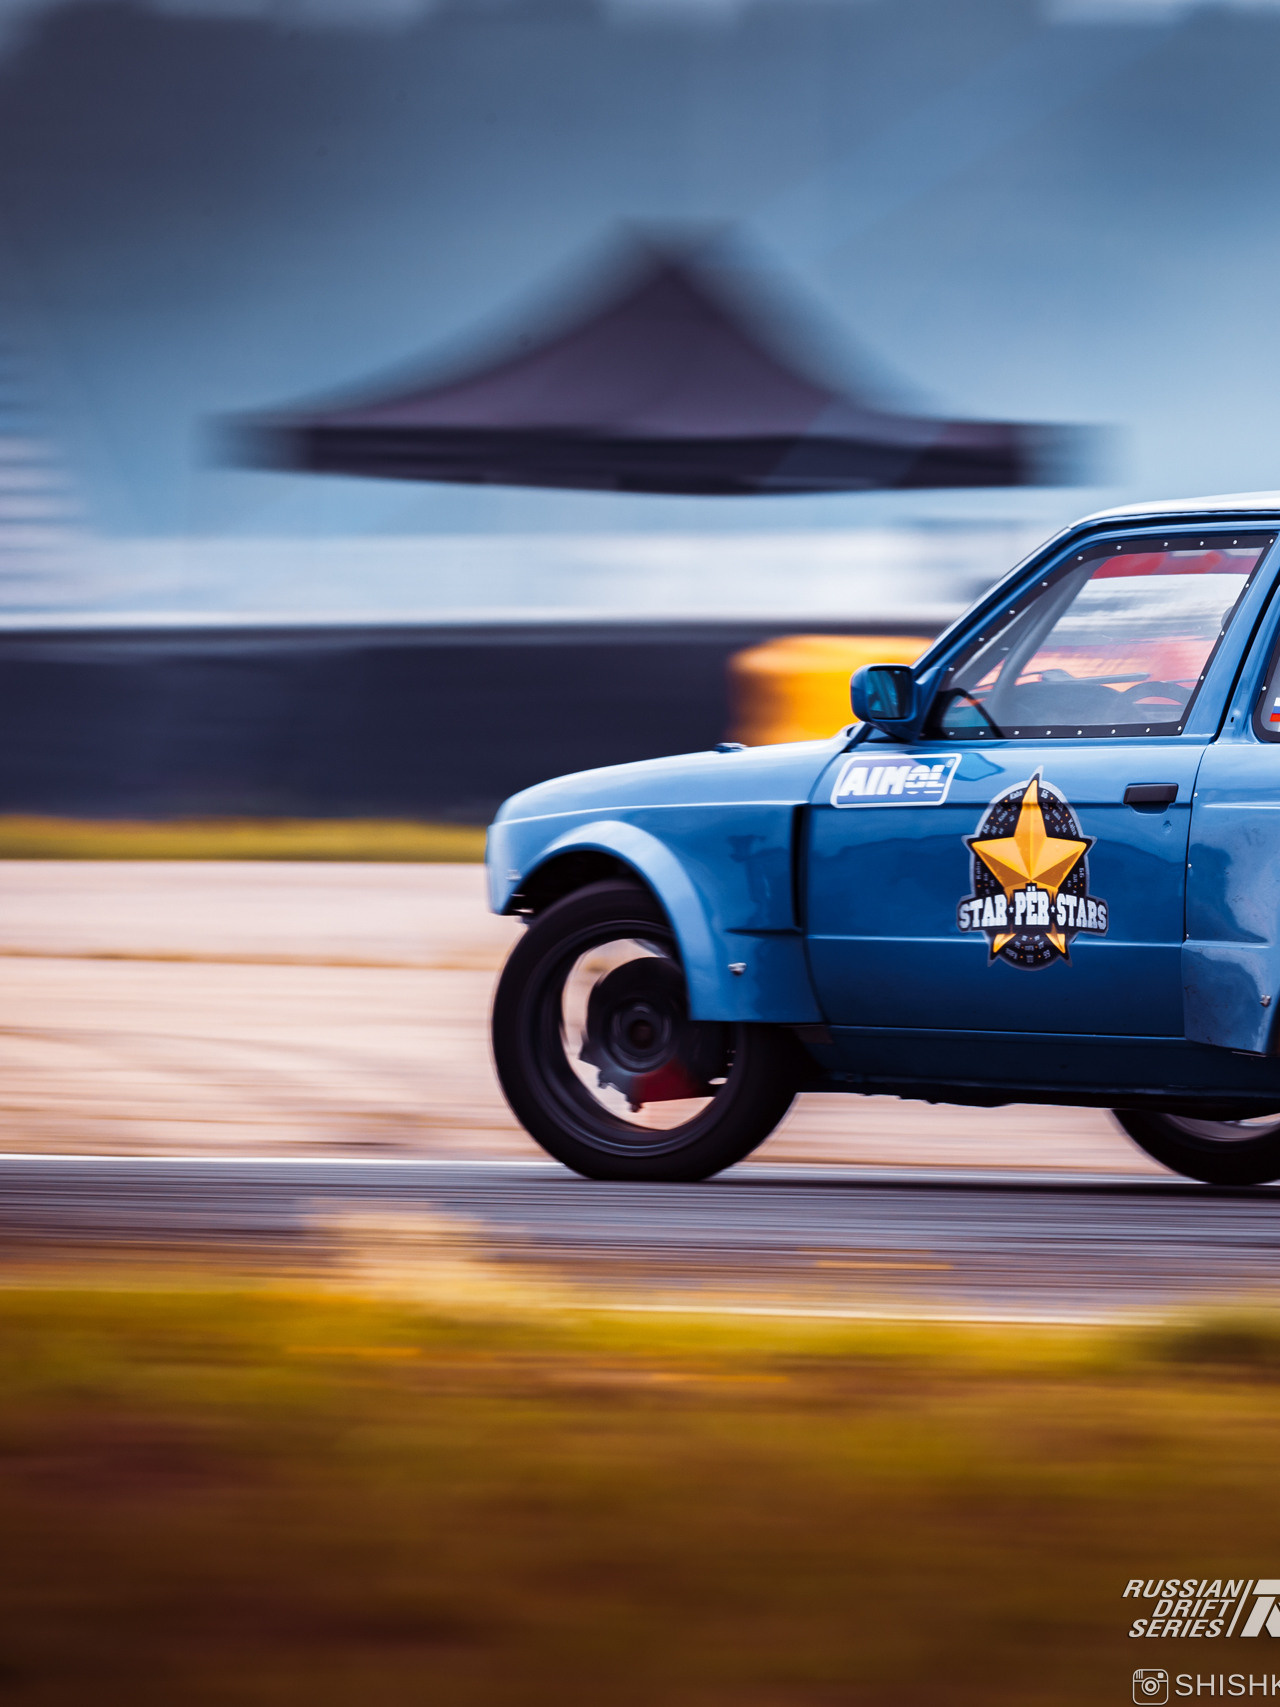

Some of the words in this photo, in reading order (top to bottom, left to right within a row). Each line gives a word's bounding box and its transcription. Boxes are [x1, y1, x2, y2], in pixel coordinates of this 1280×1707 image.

[838, 764, 945, 796] AIMOL
[959, 894, 1008, 929] STAR
[1056, 893, 1107, 930] STARS
